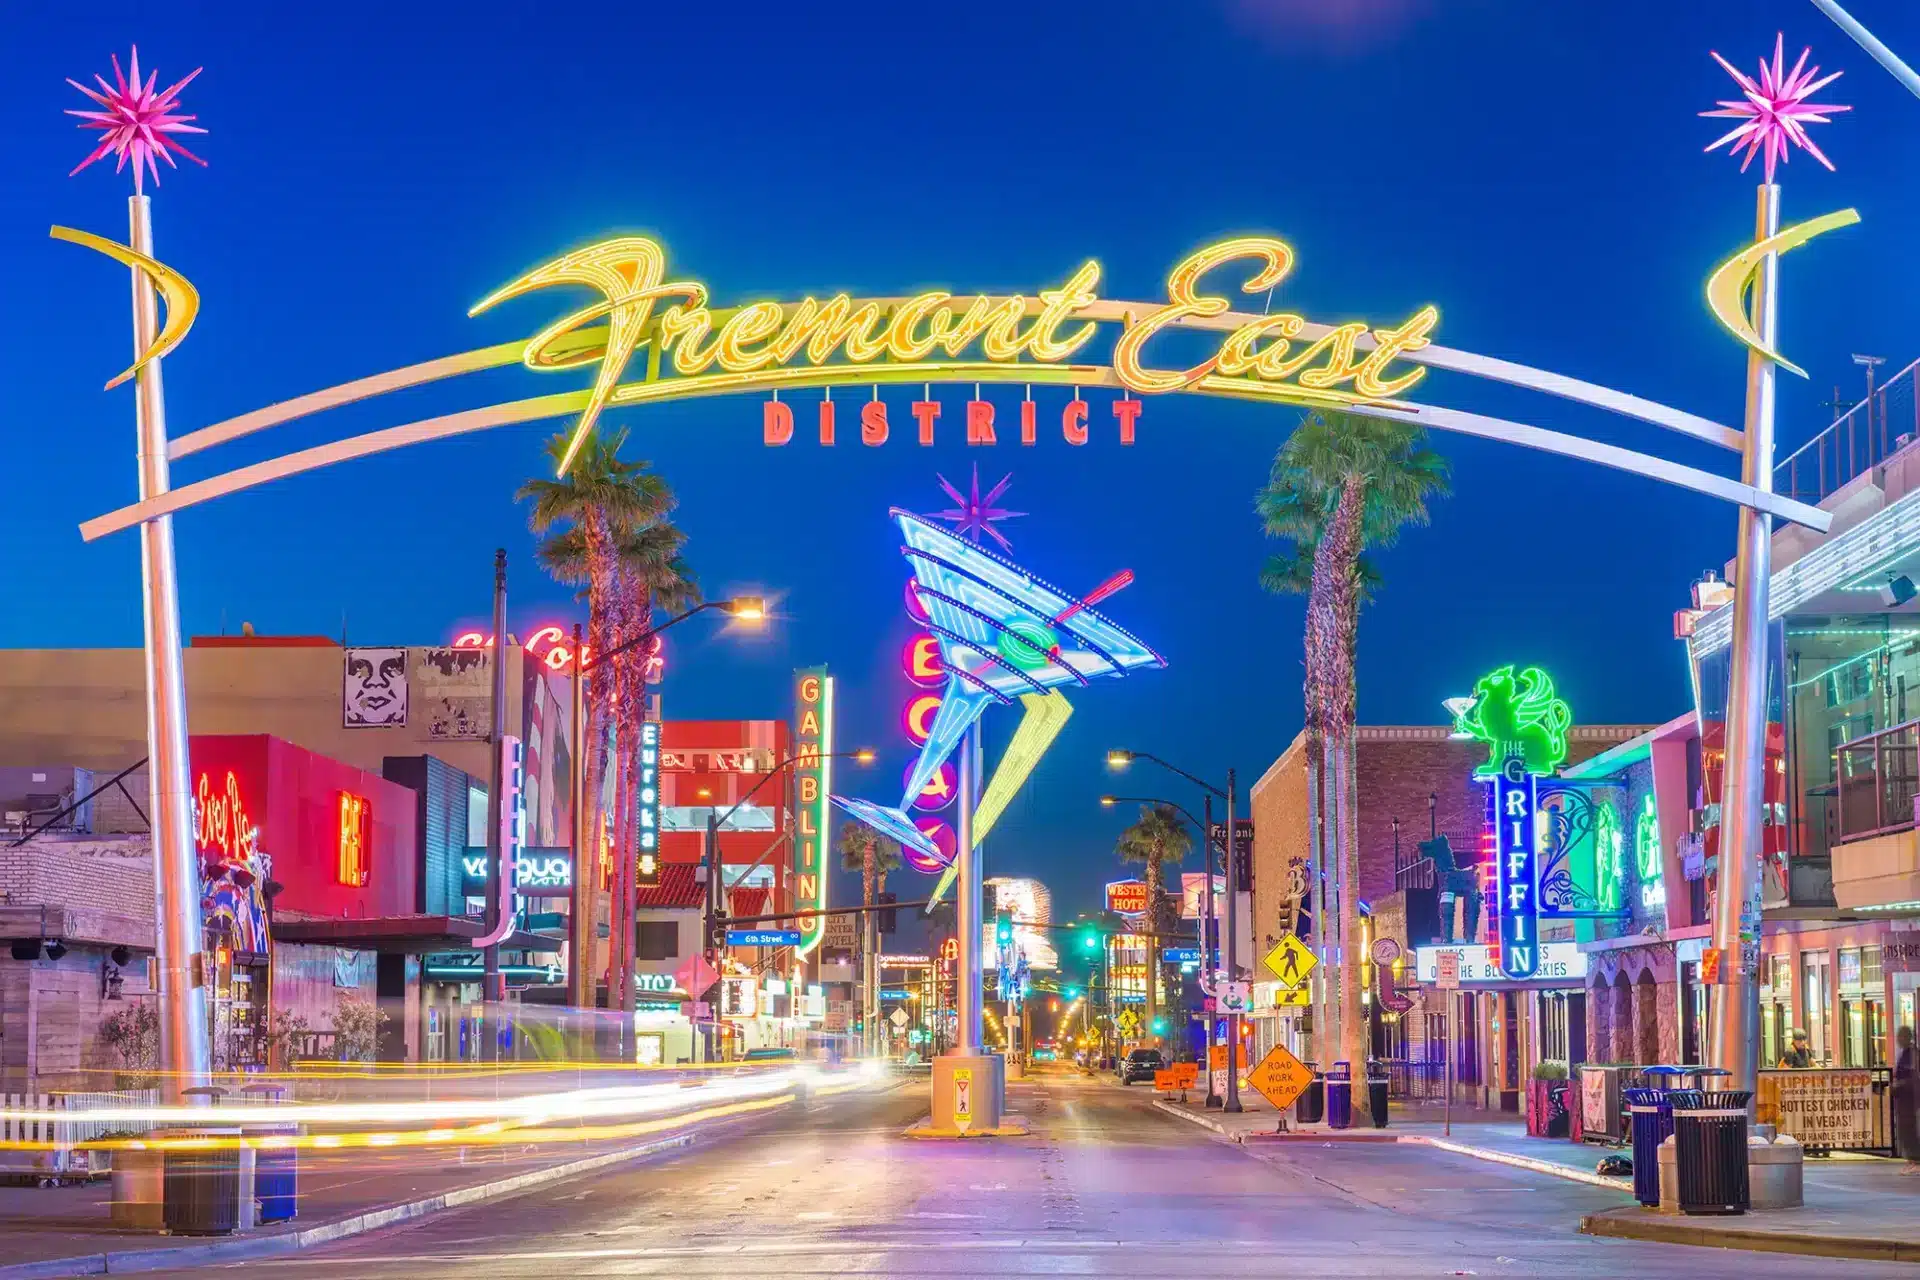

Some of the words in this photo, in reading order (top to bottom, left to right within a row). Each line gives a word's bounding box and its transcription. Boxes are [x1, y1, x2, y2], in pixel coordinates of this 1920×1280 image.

[467, 235, 1101, 478] Fremont
[1113, 236, 1441, 399] East
[764, 400, 1142, 446] DISTRICT
[1502, 740, 1525, 757] THE
[639, 724, 656, 848] Eureka
[798, 677, 820, 933] GAMBLING
[1210, 824, 1253, 838] Freont
[1502, 758, 1532, 973] GRIFFIN
[1108, 884, 1147, 896] WESTE
[1113, 899, 1146, 910] HOTE
[824, 924, 854, 933] ENTER
[745, 935, 759, 943] 6th
[761, 935, 783, 943] Street
[826, 935, 854, 946] OTEL
[1460, 965, 1473, 978] HE
[1267, 1061, 1292, 1070] ROAD
[1267, 1074, 1293, 1083] WORK
[1831, 1074, 1872, 1088] GOOD
[1266, 1087, 1298, 1095] AHEAD
[1780, 1099, 1824, 1113] HOTTEST
[1826, 1097, 1870, 1112] CHICKEN
[1802, 1115, 1813, 1128] IN
[1815, 1114, 1852, 1128] VEGAS!
[1793, 1132, 1807, 1142] YOU
[1808, 1130, 1836, 1141] HANDLE
[1837, 1130, 1851, 1140] THE
